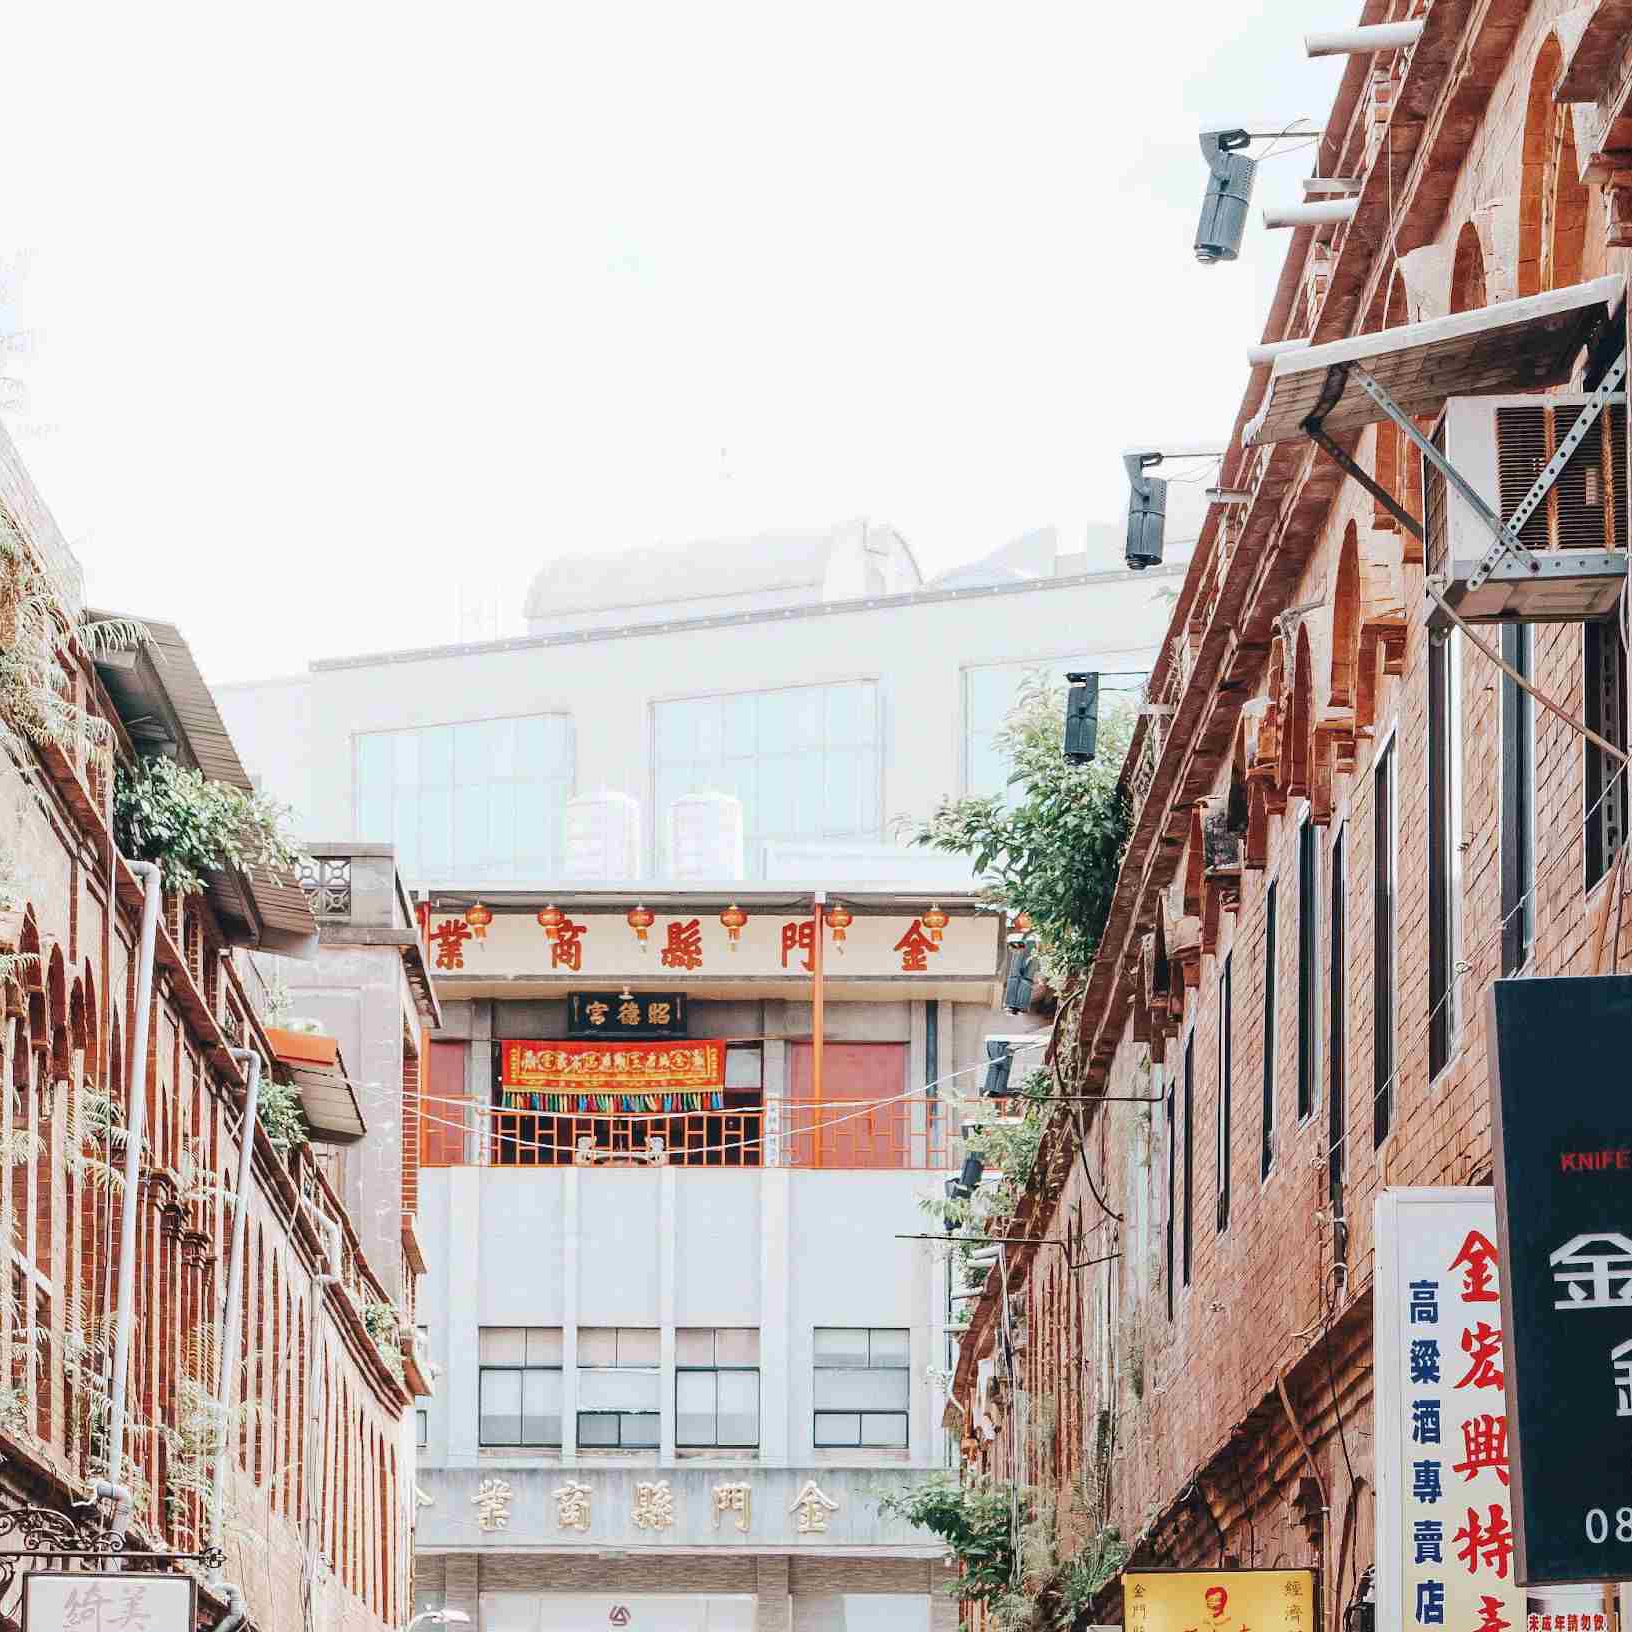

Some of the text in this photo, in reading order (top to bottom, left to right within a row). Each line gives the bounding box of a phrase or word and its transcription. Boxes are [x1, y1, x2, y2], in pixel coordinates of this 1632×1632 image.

[1560, 1149, 1631, 1172] KNIFE
[1528, 1614, 1607, 1632] 未成年請勿飲
